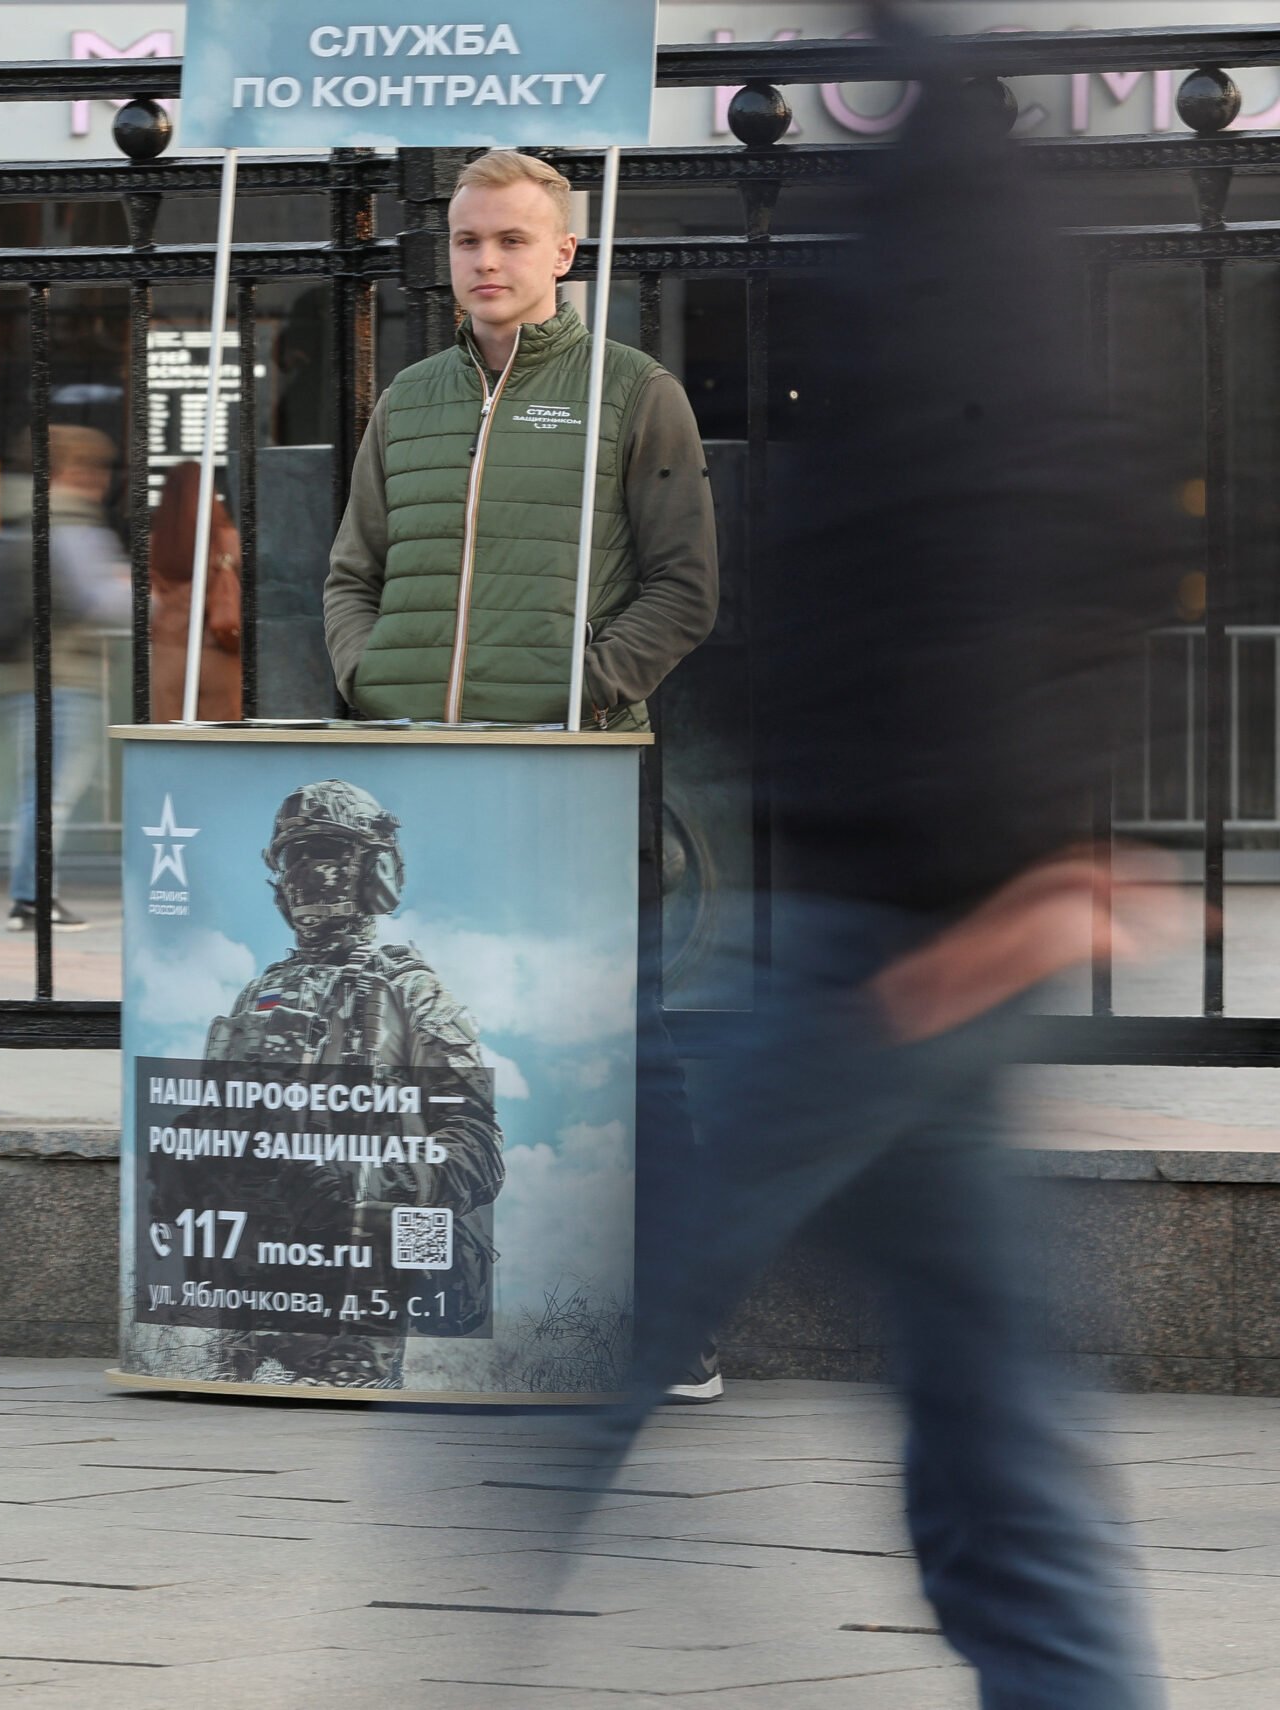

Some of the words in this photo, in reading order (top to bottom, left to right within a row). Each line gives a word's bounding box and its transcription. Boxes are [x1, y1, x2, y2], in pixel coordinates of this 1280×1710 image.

[309, 23, 521, 58] СЛУЖБА
[231, 76, 302, 108] ПО
[311, 73, 607, 107] КОНТРАКТУ
[512, 415, 582, 424] ЗАЩИТНИКОМ
[526, 408, 571, 417] СТАНЬ
[149, 1077, 221, 1107] НАША
[225, 1080, 421, 1113] ПРОФЕССИЯ
[149, 1126, 251, 1161] РОДИНУ
[252, 1131, 449, 1167] ЗАЩИЩАТЬ
[175, 1208, 248, 1260] 117
[257, 1241, 373, 1269] mos.ru
[148, 1283, 177, 1311] ул.
[181, 1280, 332, 1319] Яблочкова,
